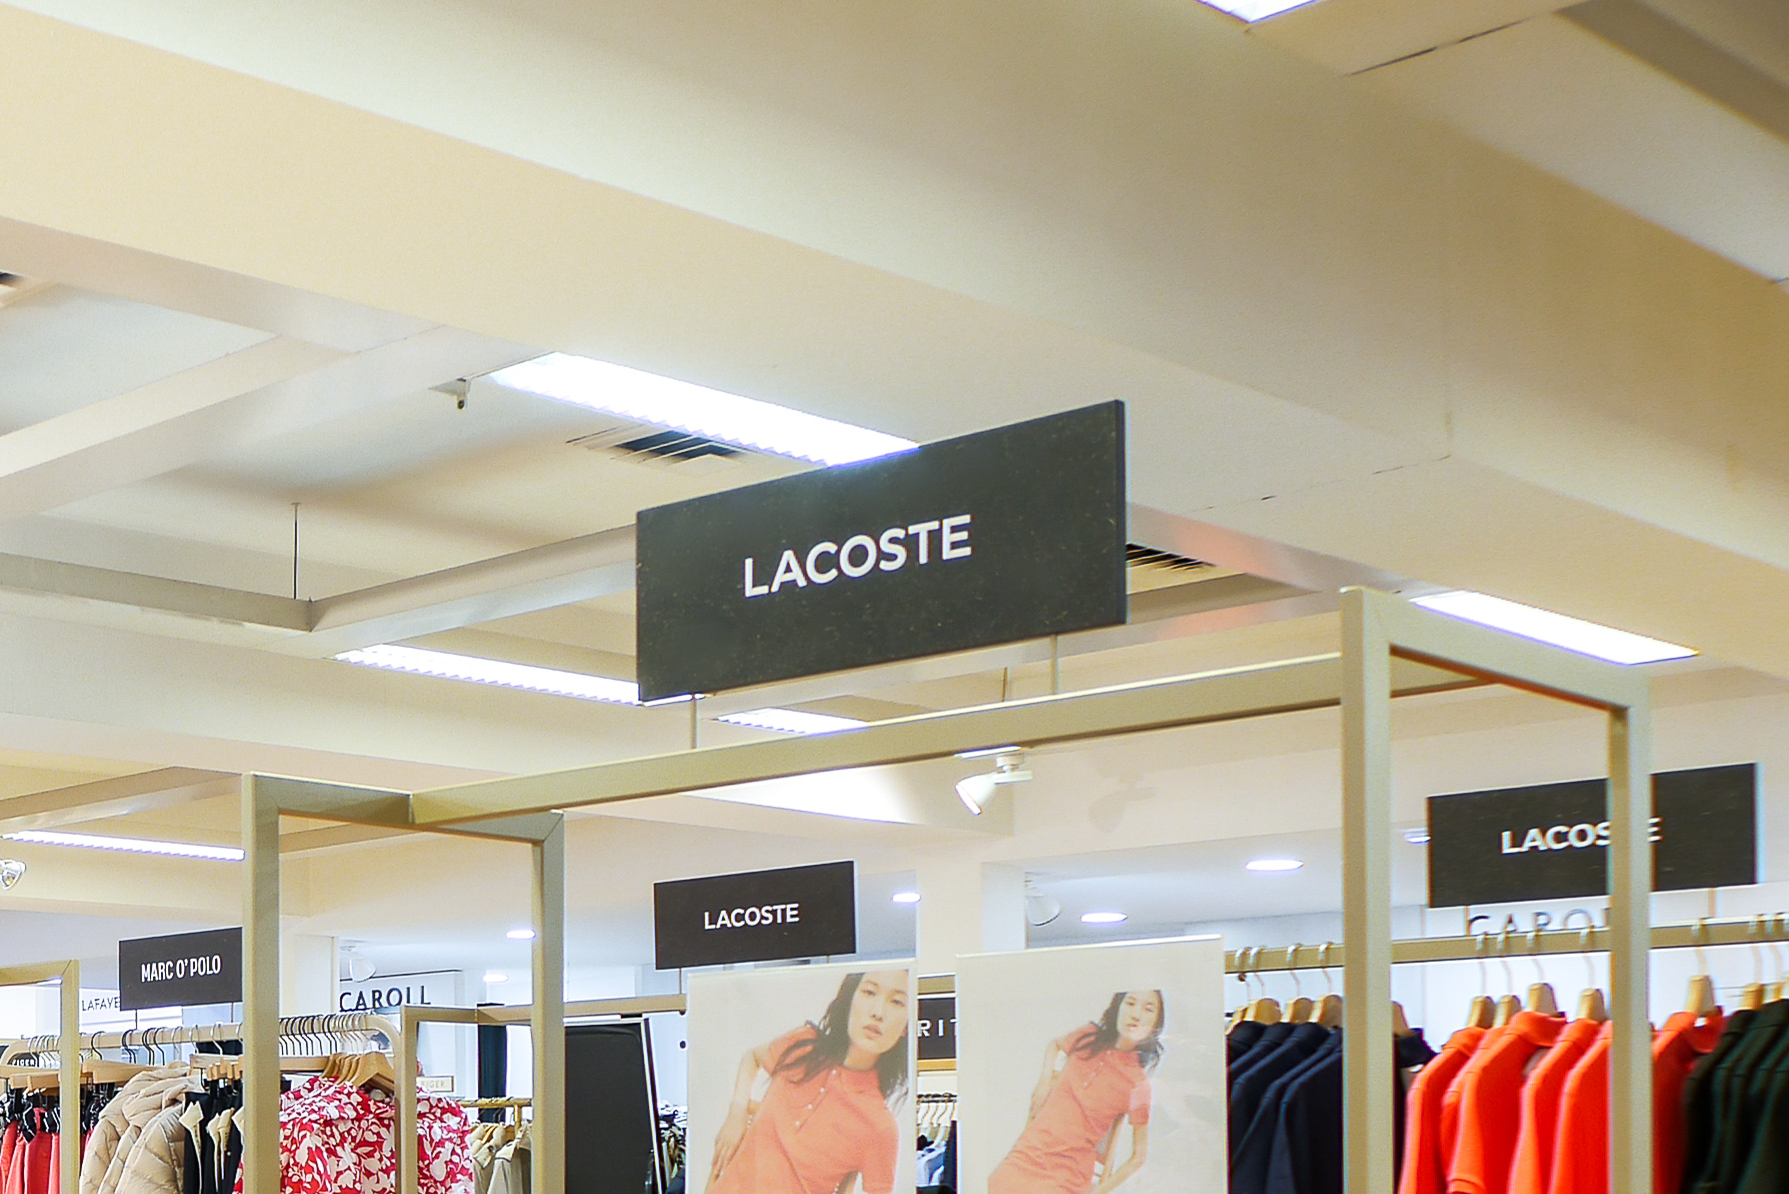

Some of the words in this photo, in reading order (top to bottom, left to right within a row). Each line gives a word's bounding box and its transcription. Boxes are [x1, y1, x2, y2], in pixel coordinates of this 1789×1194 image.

[743, 514, 973, 599] LACOSTE
[1500, 816, 1663, 855] LACOSE
[704, 903, 800, 930] LACOSTE
[141, 960, 174, 983] MARC
[190, 954, 222, 977] POLO
[81, 996, 121, 1012] LAFAYE
